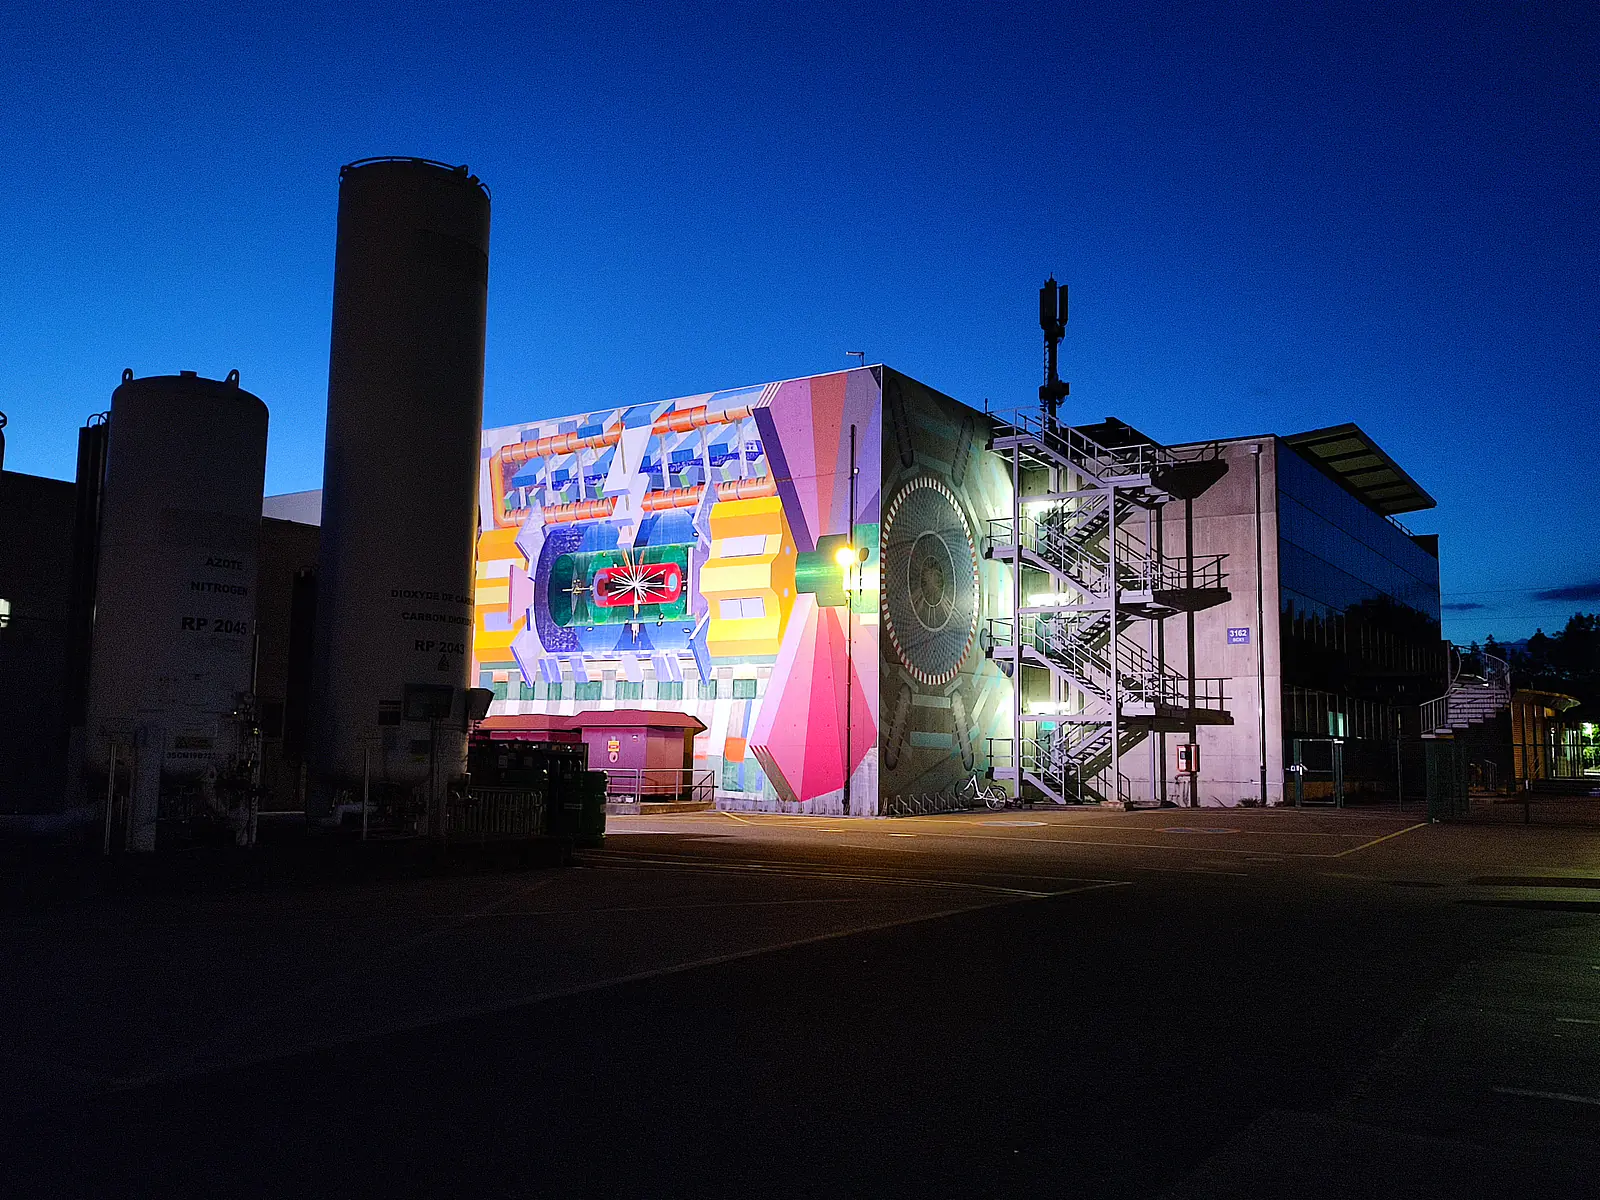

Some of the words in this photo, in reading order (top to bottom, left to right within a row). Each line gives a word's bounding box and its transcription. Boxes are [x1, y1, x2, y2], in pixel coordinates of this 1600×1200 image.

[205, 557, 243, 571] AZOTE
[190, 581, 248, 596] NITROGEN
[391, 590, 439, 600] DIOXYDE
[442, 593, 454, 602] DE
[401, 612, 446, 622] CARBON
[181, 617, 208, 631] RP
[213, 619, 248, 635] 2045
[1229, 629, 1247, 637] 3162
[414, 640, 435, 652] RP
[439, 642, 465, 655] 2043
